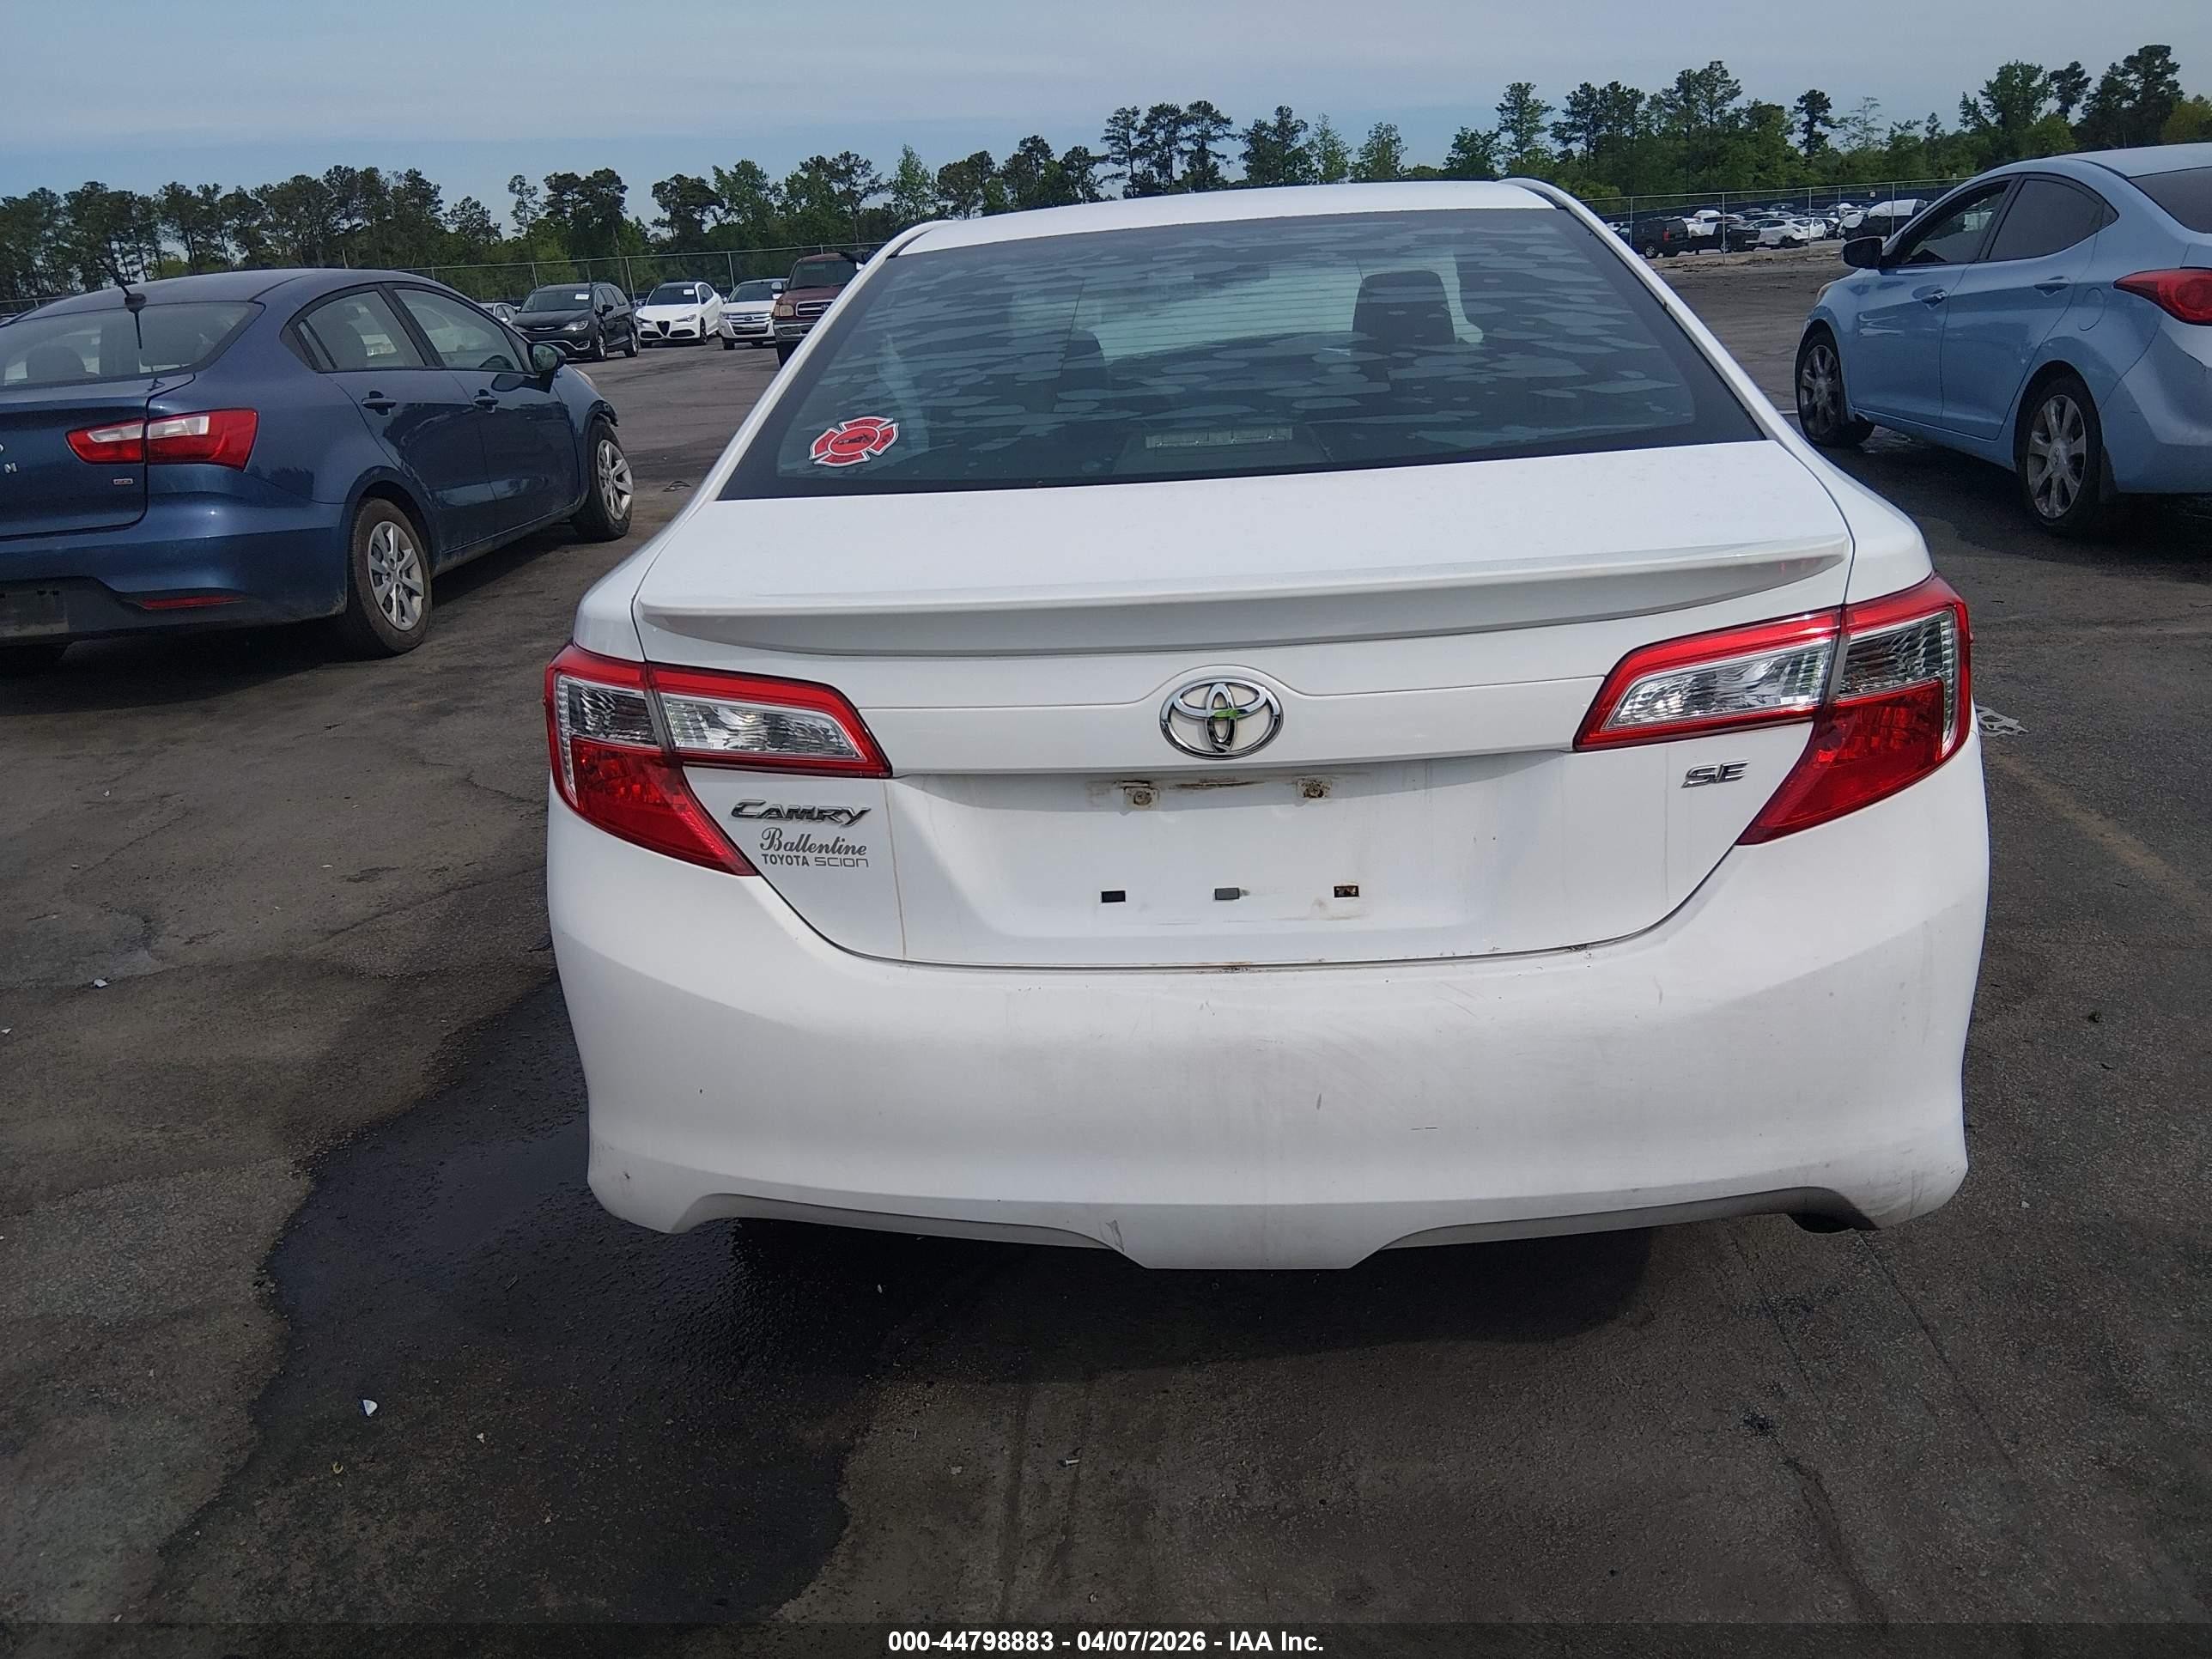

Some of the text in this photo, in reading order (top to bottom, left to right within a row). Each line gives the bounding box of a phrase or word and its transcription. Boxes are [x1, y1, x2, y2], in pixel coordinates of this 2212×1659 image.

[1680, 760, 1750, 788] SE
[731, 799, 872, 827] CAMRY
[759, 827, 867, 856] Ballentine
[761, 854, 810, 866] TOYOTA
